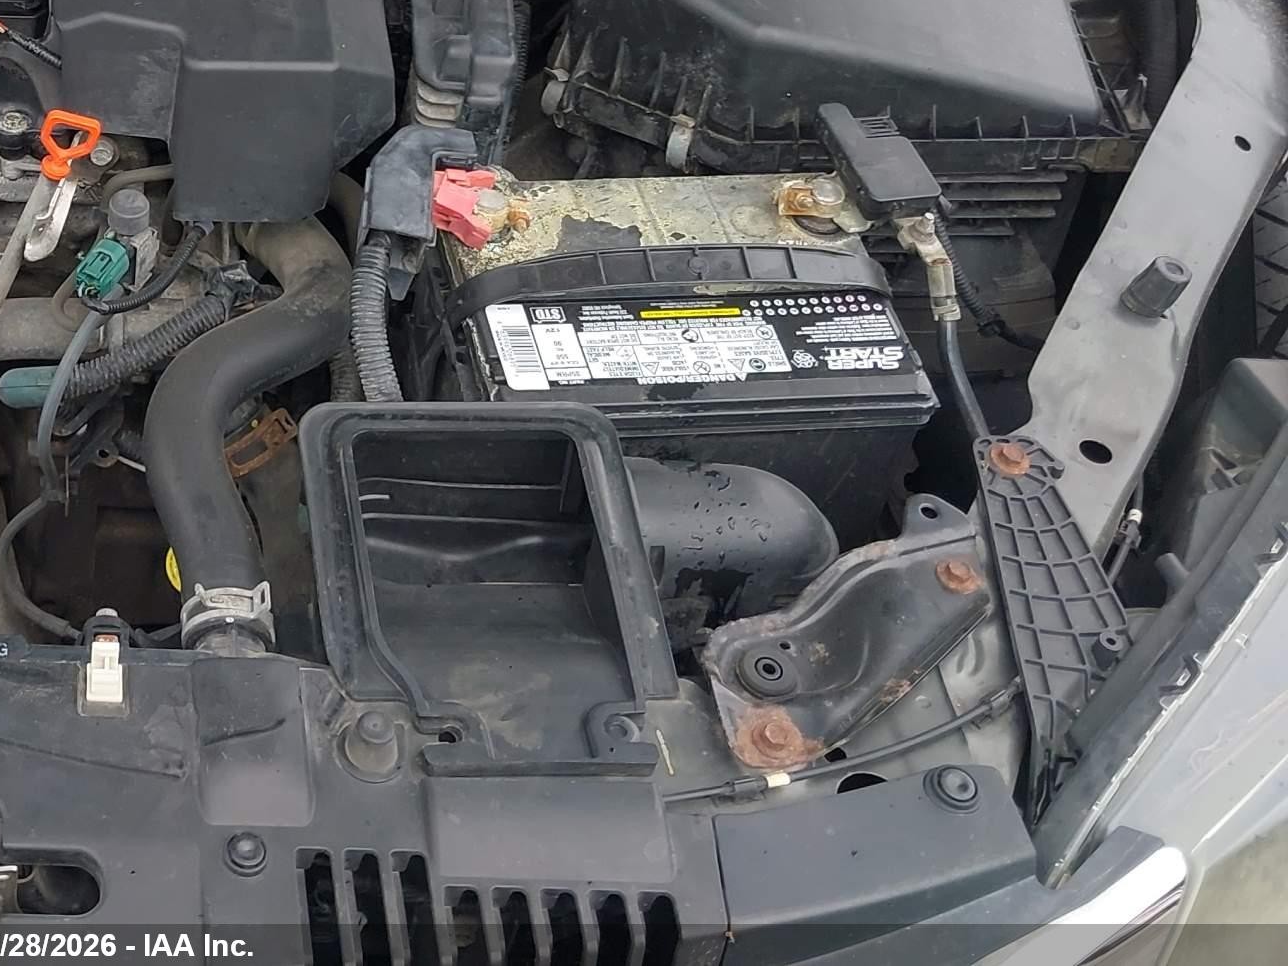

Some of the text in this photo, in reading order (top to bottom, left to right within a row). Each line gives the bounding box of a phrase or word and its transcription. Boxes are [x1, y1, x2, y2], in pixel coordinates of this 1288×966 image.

[535, 309, 561, 320] STD
[824, 346, 904, 360] START
[827, 359, 900, 370] SUPER
